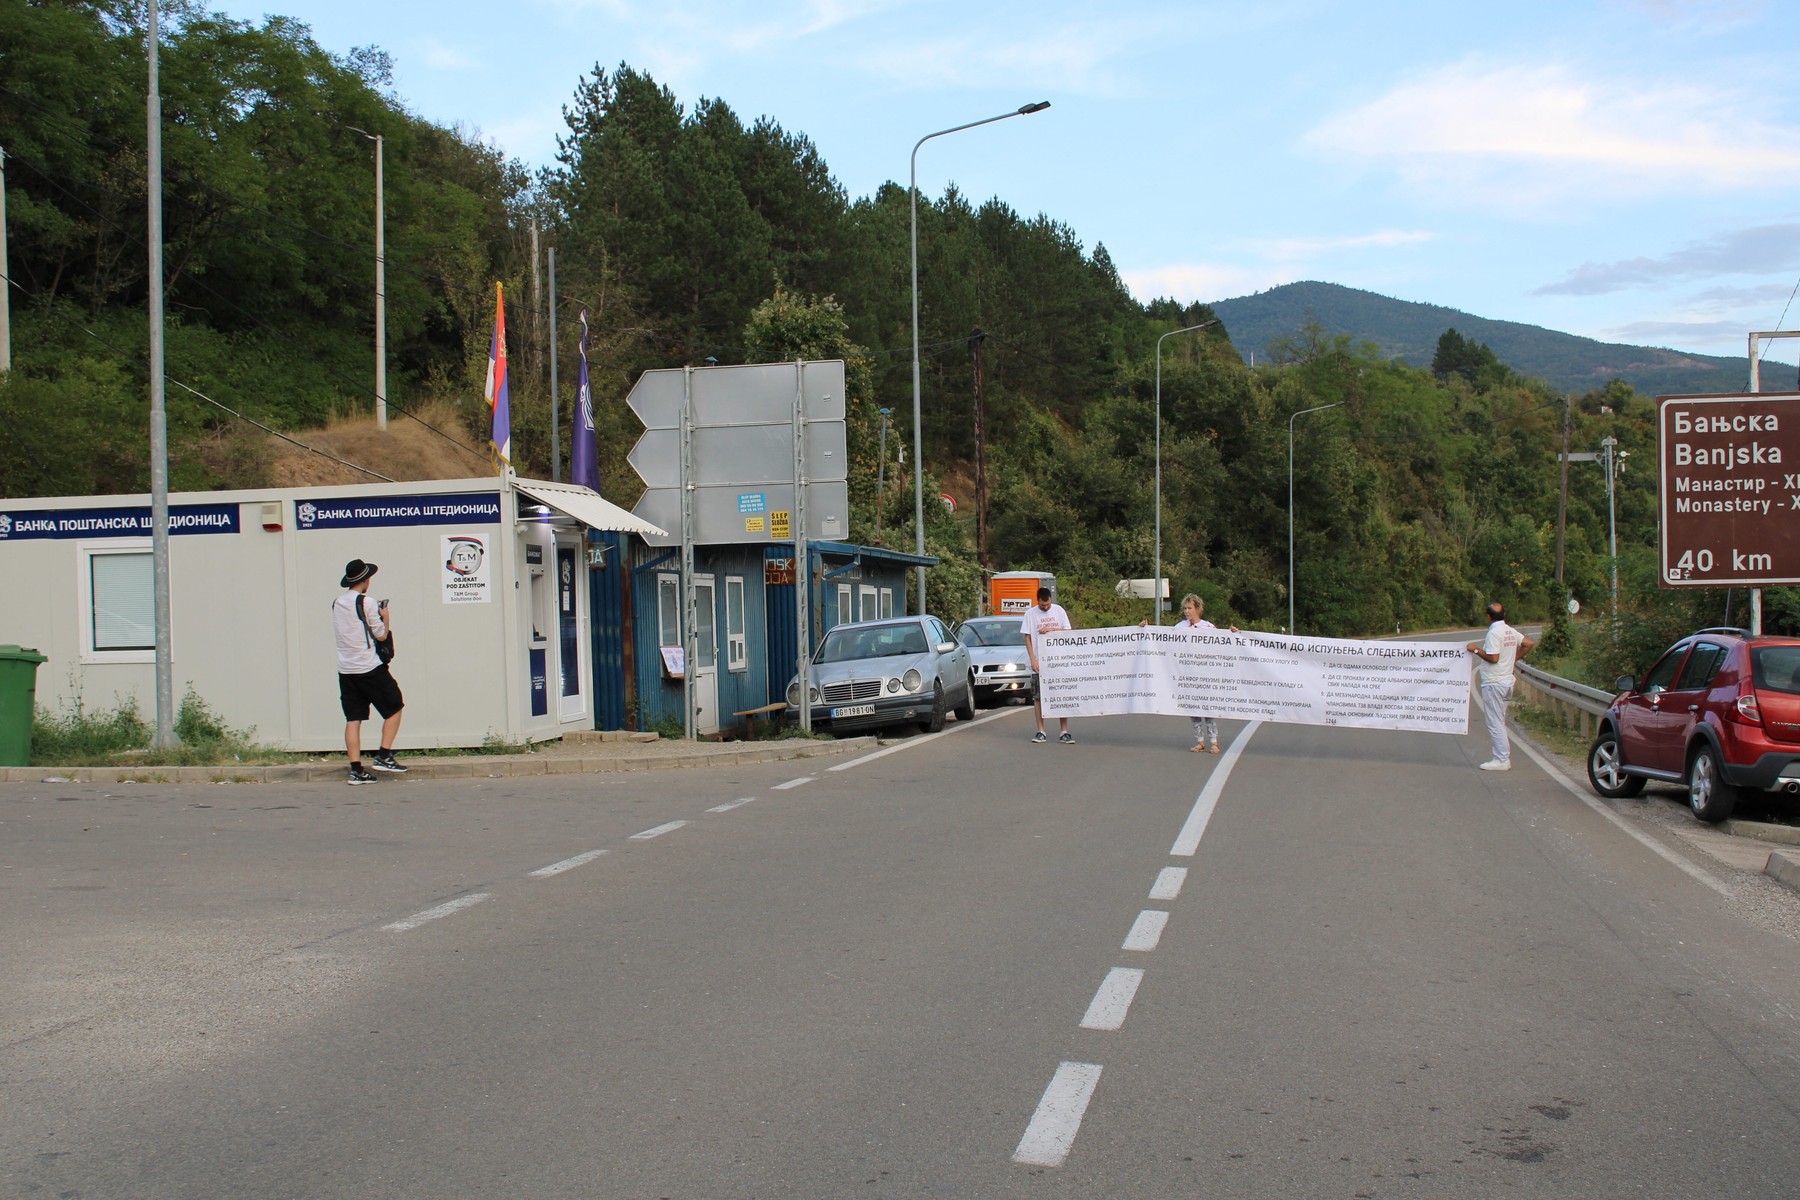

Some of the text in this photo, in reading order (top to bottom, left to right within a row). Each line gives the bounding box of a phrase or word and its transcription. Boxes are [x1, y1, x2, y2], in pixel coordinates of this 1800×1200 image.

[1675, 412, 1778, 434] Бањска
[1675, 442, 1782, 470] Banjska
[1676, 477, 1765, 494] Манастир
[318, 504, 499, 520] БАНКА ПОШТАНСКА ШТЕДИОНИЦА
[1676, 496, 1770, 514] Monastery
[15, 514, 231, 532] БАНКА ПОШТАНСКА ШДИОНИЦА
[1678, 549, 1772, 572] 40 km
[1046, 632, 1464, 658] БЛОКАДЕ АДМИНИСТРАТИВНИХ ПРЕЛАЗА ЋЕ ТРАЈАТИ ДО ИСПУЊЕЊА СЛЕДЕЋИХ ЗАХТЕВА:
